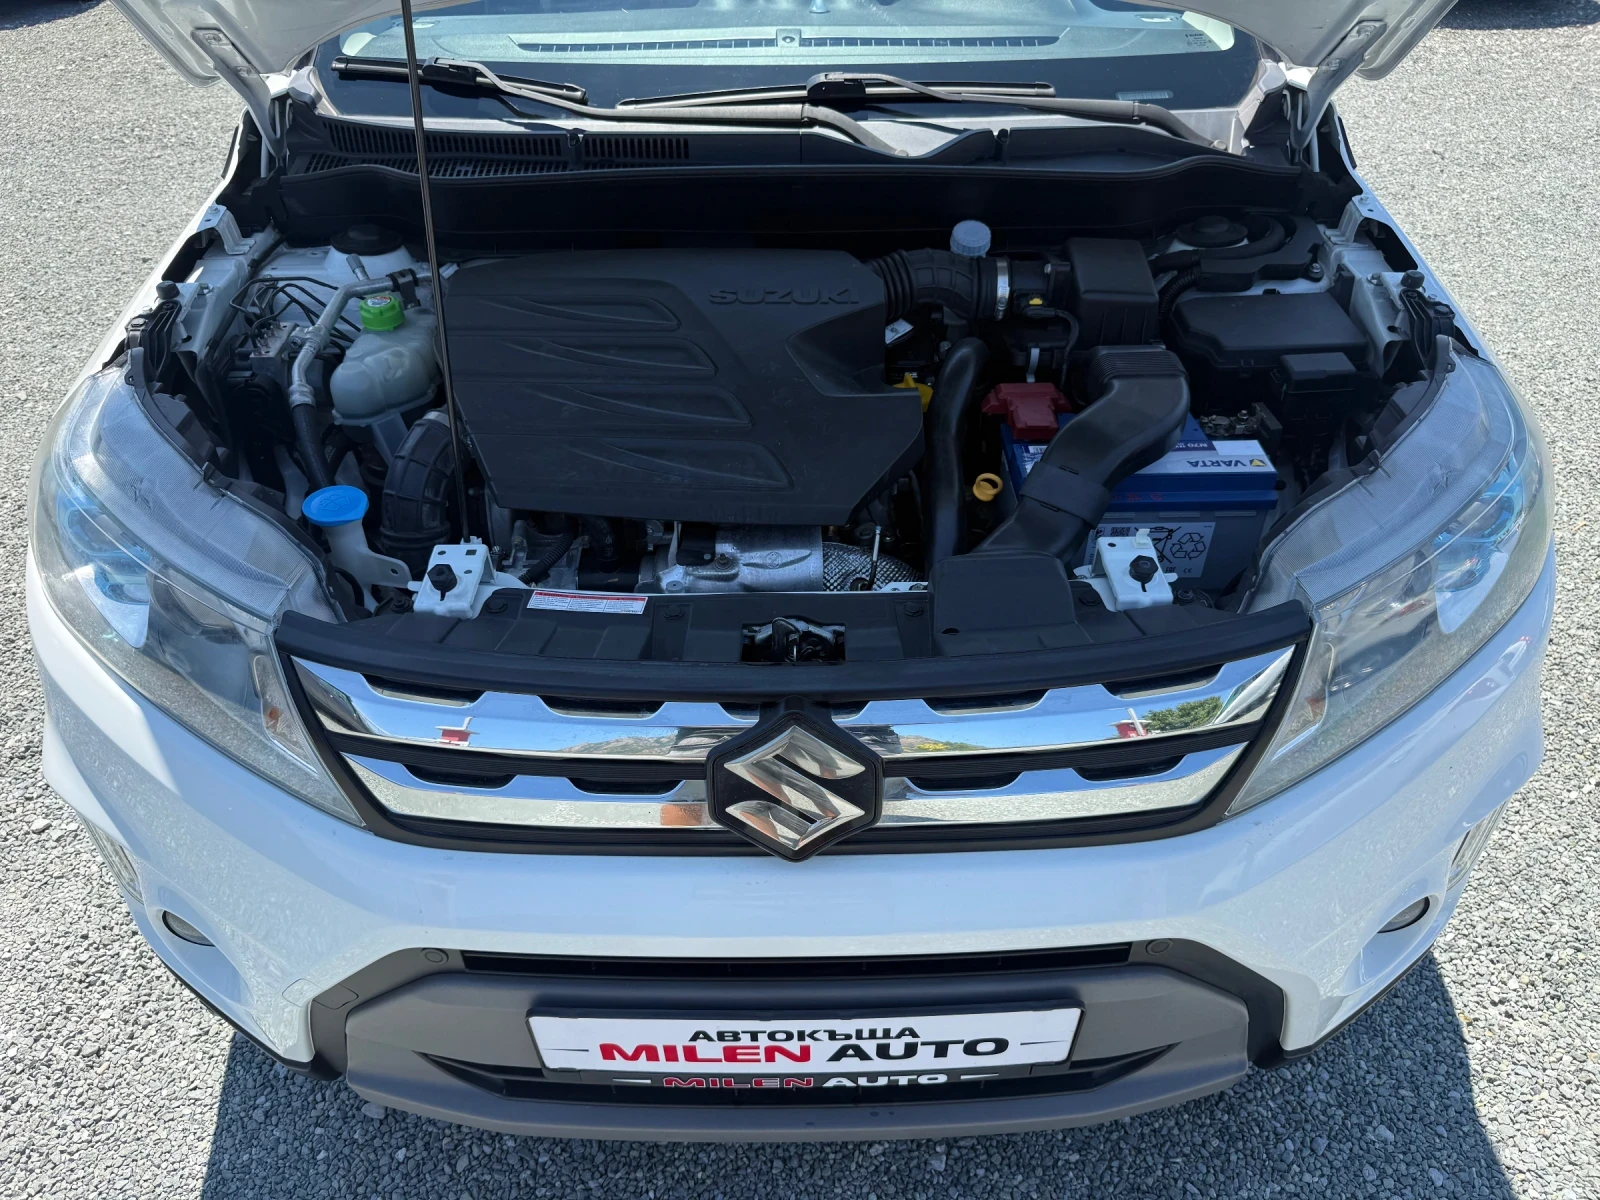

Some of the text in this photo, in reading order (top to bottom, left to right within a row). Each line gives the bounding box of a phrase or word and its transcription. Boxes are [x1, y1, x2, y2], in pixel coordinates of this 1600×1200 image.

[709, 287, 860, 305] SUZUKI
[1186, 459, 1247, 467] VARTA
[688, 1026, 920, 1043] АВТОКЪЩА
[599, 1037, 1009, 1063] MILEN AUTO
[663, 1073, 948, 1088] MILEN AUTO
